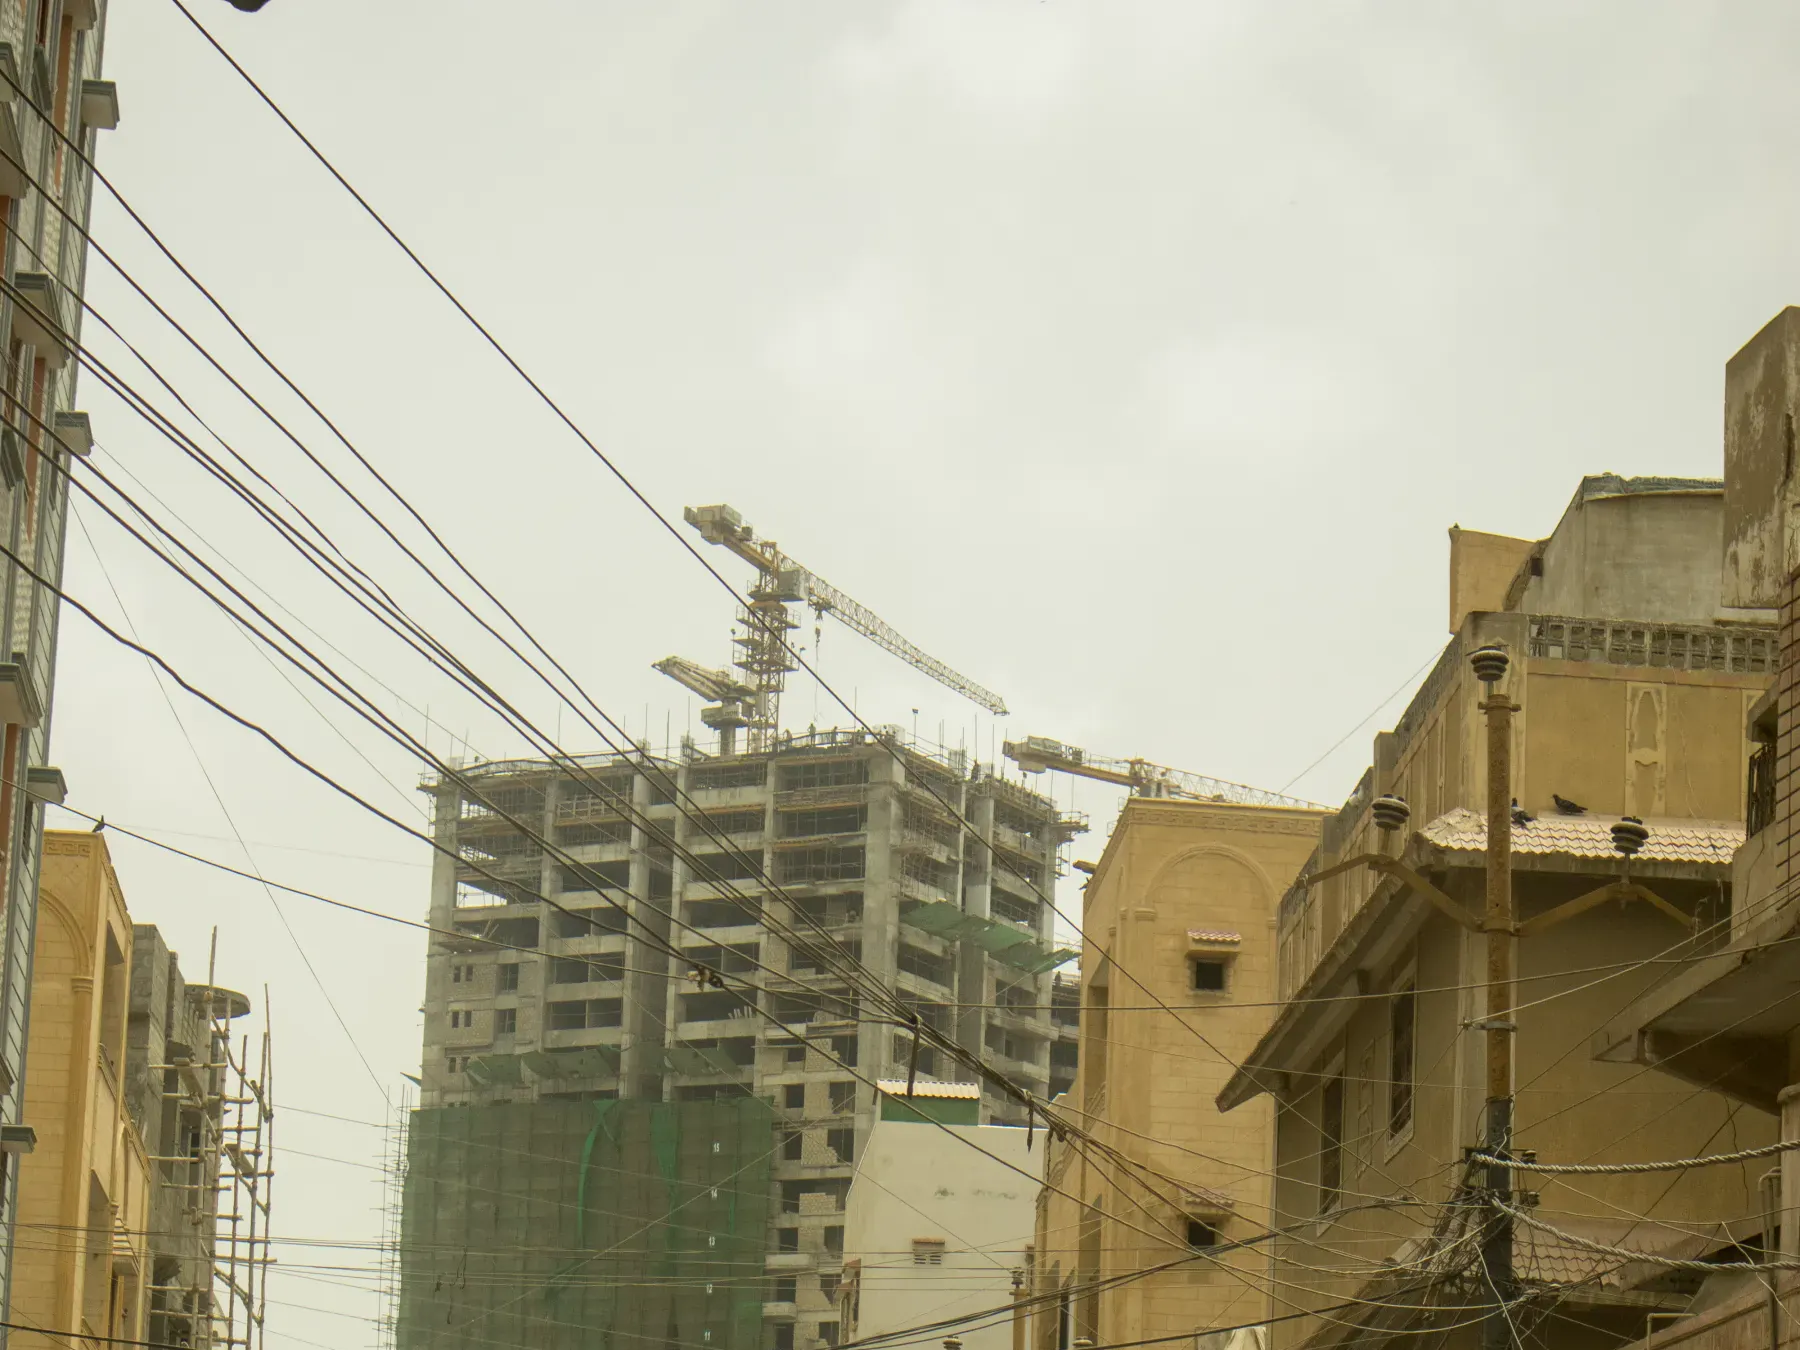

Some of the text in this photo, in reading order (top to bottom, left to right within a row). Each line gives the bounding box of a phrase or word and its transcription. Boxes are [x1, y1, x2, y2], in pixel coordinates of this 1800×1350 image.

[713, 1142, 720, 1152] 15
[711, 1189, 718, 1198] 14
[708, 1236, 716, 1246] 13
[706, 1284, 713, 1293] 12
[704, 1331, 711, 1340] 11
